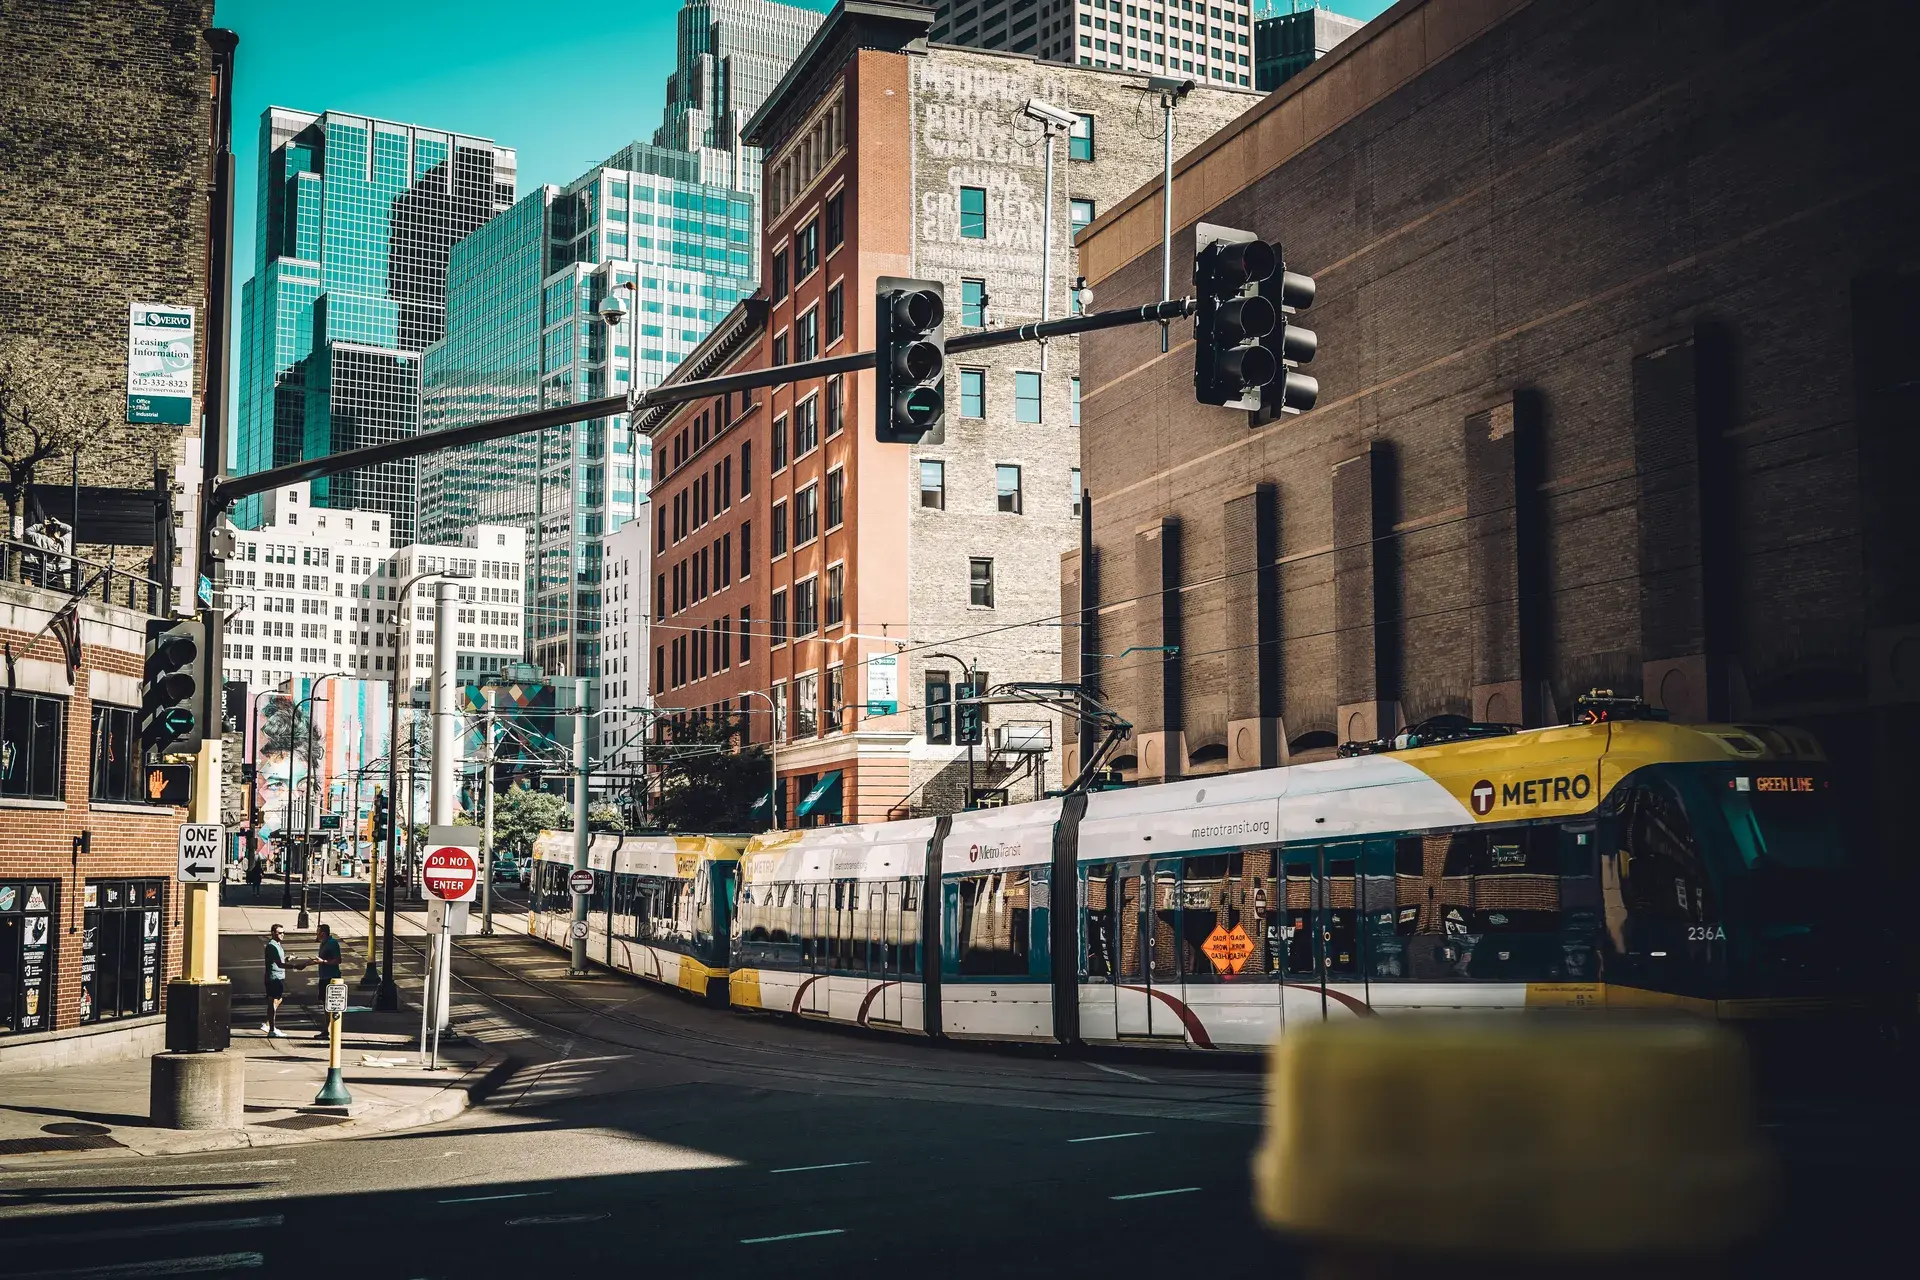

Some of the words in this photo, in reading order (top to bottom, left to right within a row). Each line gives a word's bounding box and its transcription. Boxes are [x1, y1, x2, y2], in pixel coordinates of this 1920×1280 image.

[147, 313, 190, 326] SWERVO
[134, 337, 169, 349] Leasing
[134, 348, 189, 359] Information
[132, 378, 188, 388] 612-332-8323
[1502, 774, 1591, 806] METRO
[1757, 777, 1788, 792] GREEN
[1789, 777, 1815, 792] LINE
[185, 828, 217, 841] ONE
[1191, 820, 1269, 838] metrotransit.org
[184, 845, 218, 858] WAY
[431, 856, 445, 866] DO
[449, 857, 468, 866] NOT
[433, 880, 464, 890] ENTER
[1687, 926, 1726, 940] 236A
[81, 964, 95, 973] SEBALL
